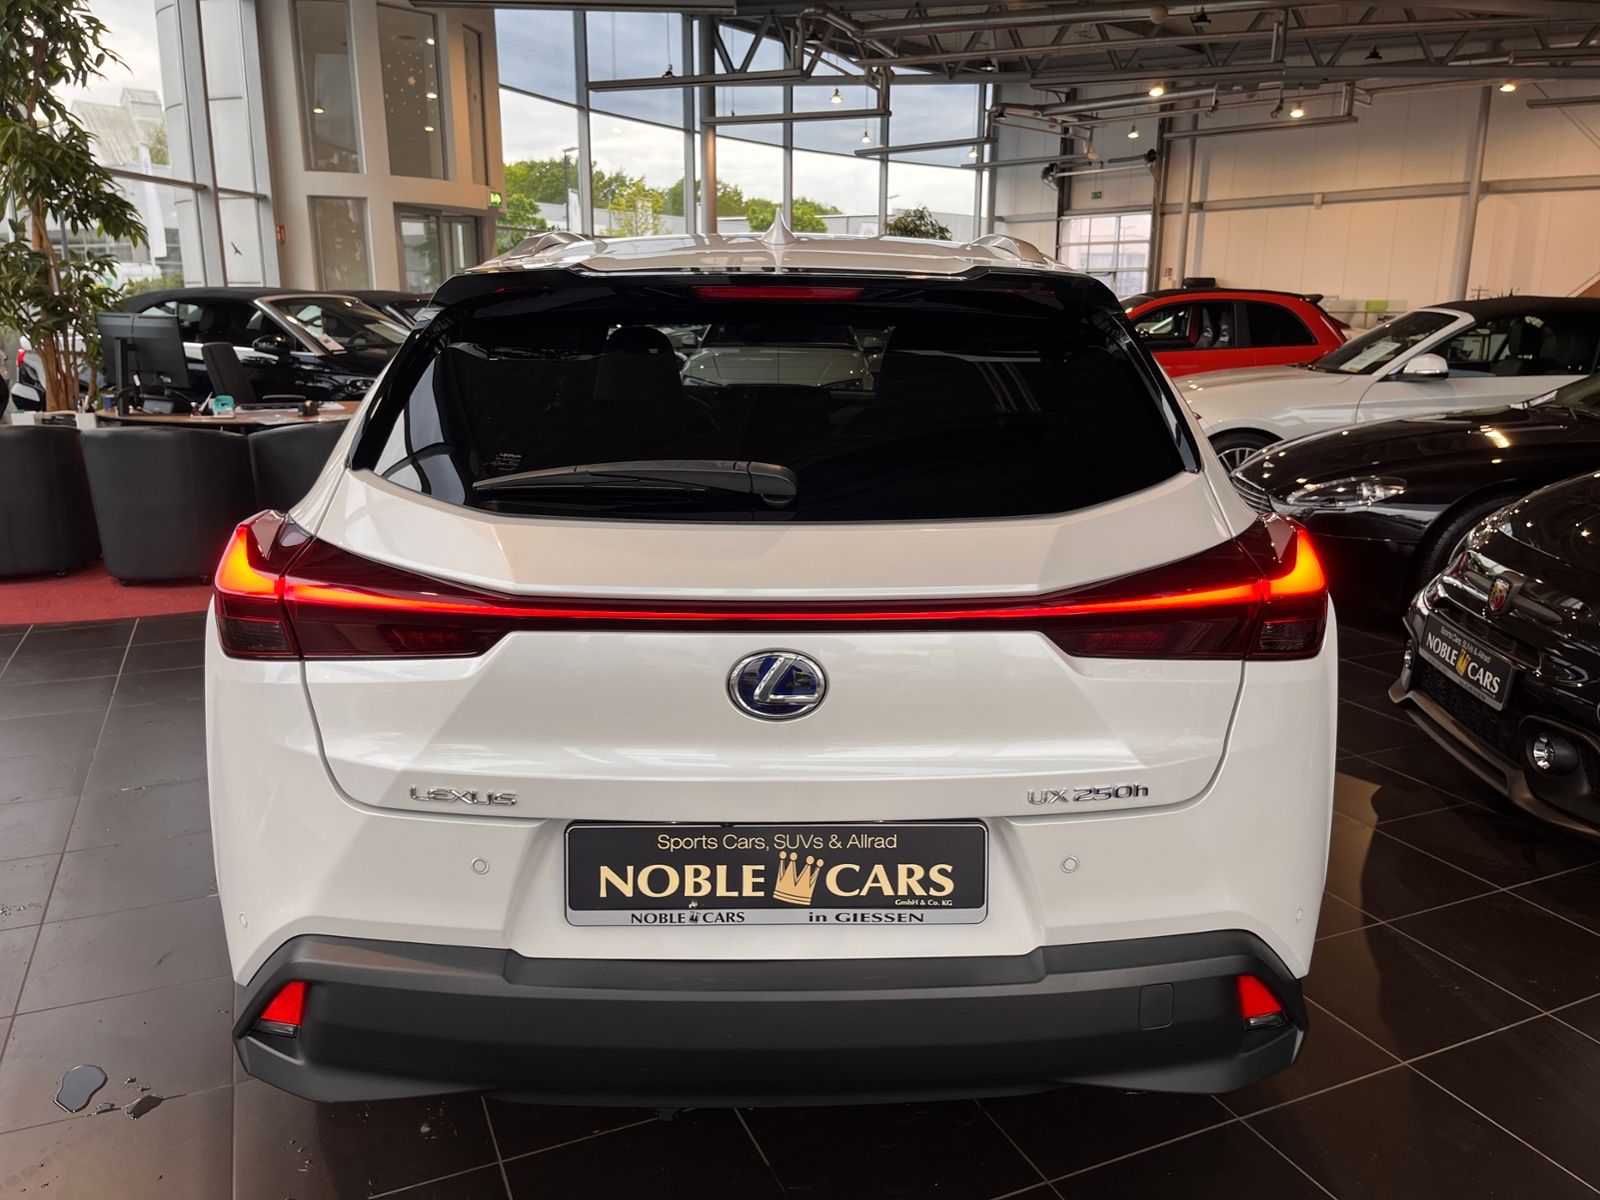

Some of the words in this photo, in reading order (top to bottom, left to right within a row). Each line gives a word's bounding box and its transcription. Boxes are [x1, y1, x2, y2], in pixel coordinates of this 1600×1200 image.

[1426, 631, 1458, 666] NOBLE
[1467, 662, 1500, 694] CARS
[410, 786, 517, 806] LEXUS
[1027, 789, 1069, 805] UX
[1073, 783, 1149, 801] 250h
[657, 834, 718, 852] Sports
[722, 834, 769, 852] Cars,
[773, 834, 824, 849] SUVs
[828, 834, 843, 849] &
[846, 834, 898, 849] Allrad
[599, 864, 765, 898] NOBLE
[825, 863, 955, 897] CARS
[630, 913, 686, 924] NOBLE
[702, 911, 746, 923] CARS
[808, 912, 828, 922] in
[834, 912, 924, 923] GIESSEN
